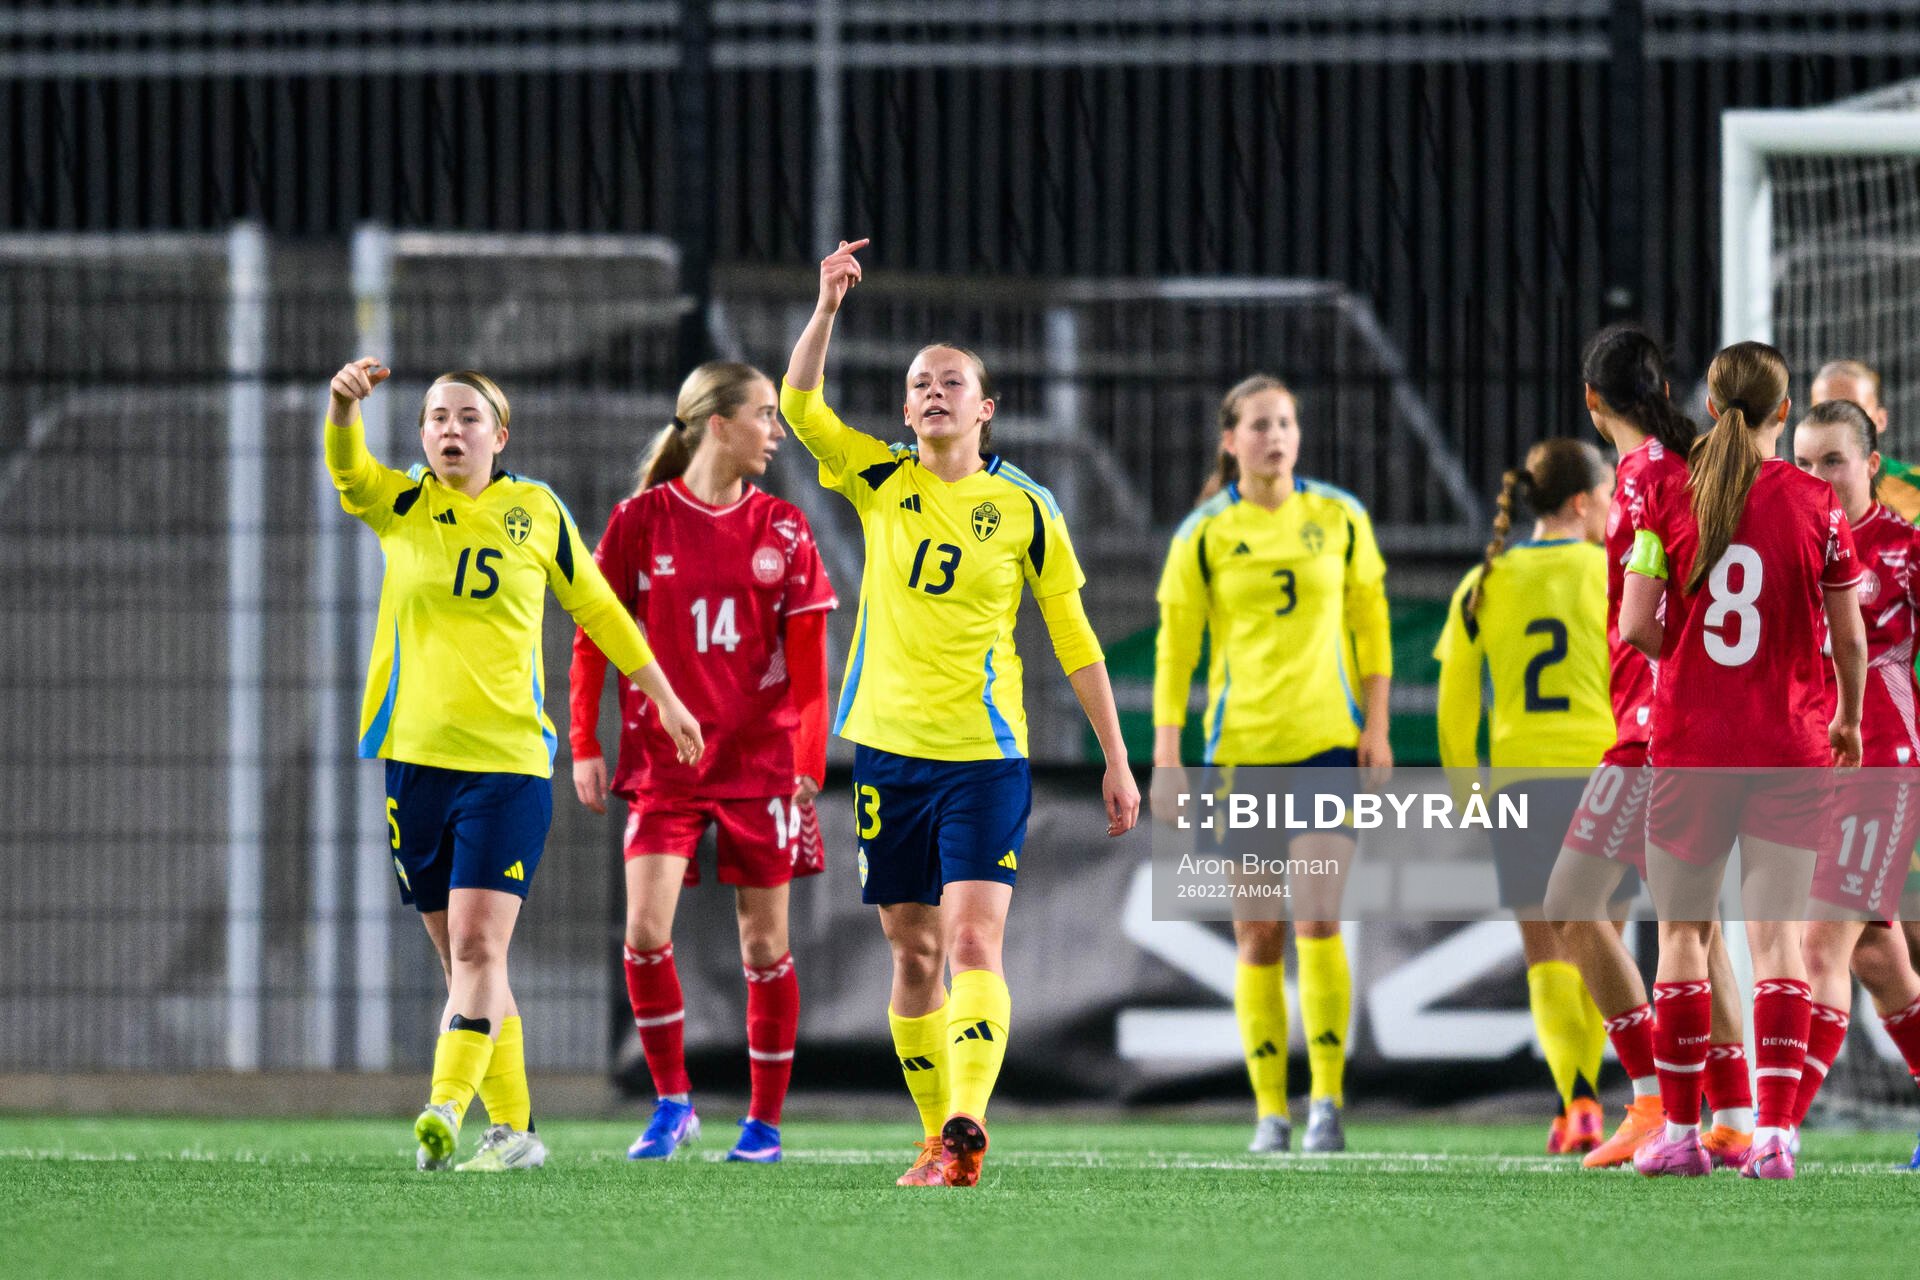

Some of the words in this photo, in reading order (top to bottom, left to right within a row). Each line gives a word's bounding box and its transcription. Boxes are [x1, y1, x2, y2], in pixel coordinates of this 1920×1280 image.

[452, 547, 504, 600] 15
[907, 538, 962, 596] 13
[1274, 569, 1297, 616] 3
[690, 597, 741, 653] 14
[1703, 544, 1764, 667] 8
[1523, 617, 1571, 714] 2
[1577, 762, 1625, 816] 10
[1838, 814, 1880, 872] 11
